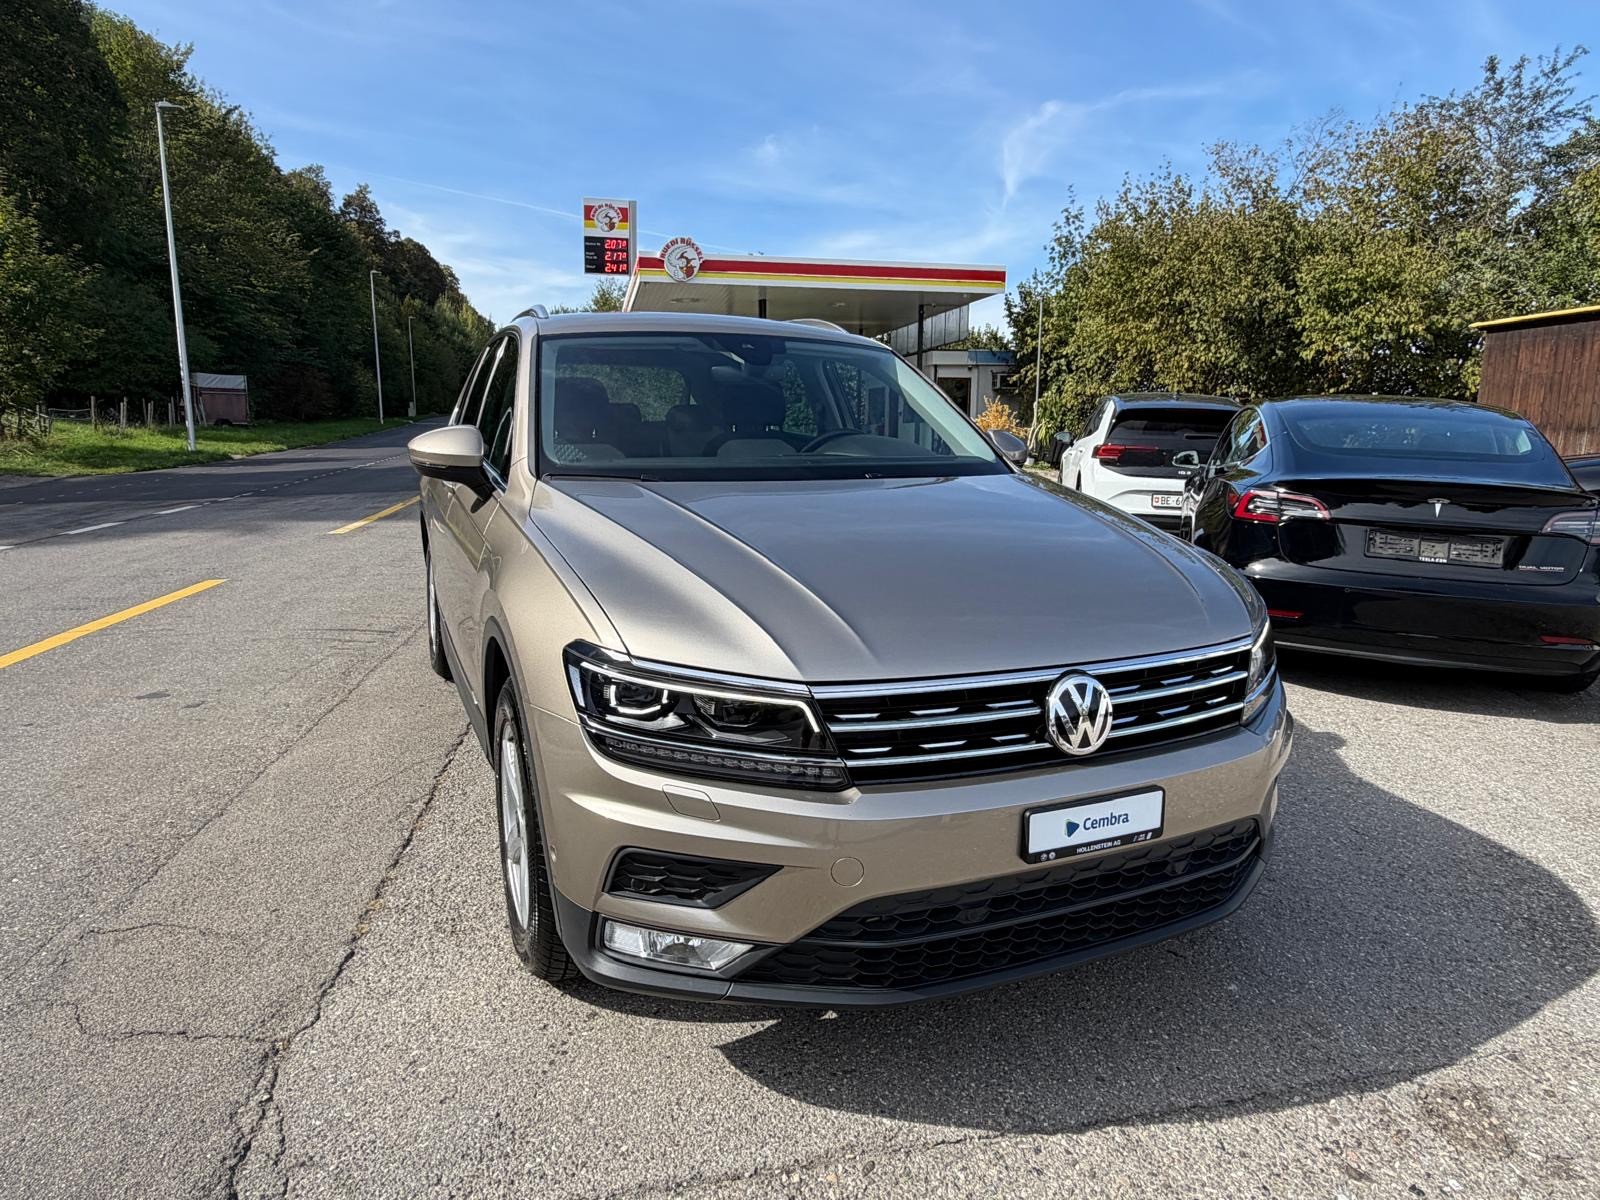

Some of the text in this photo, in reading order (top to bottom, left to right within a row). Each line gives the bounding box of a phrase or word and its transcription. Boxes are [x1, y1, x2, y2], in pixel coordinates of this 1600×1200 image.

[660, 236, 704, 262] RUEDI RÜSSEL
[1083, 812, 1130, 831] Cembra
[1113, 839, 1121, 847] AG
